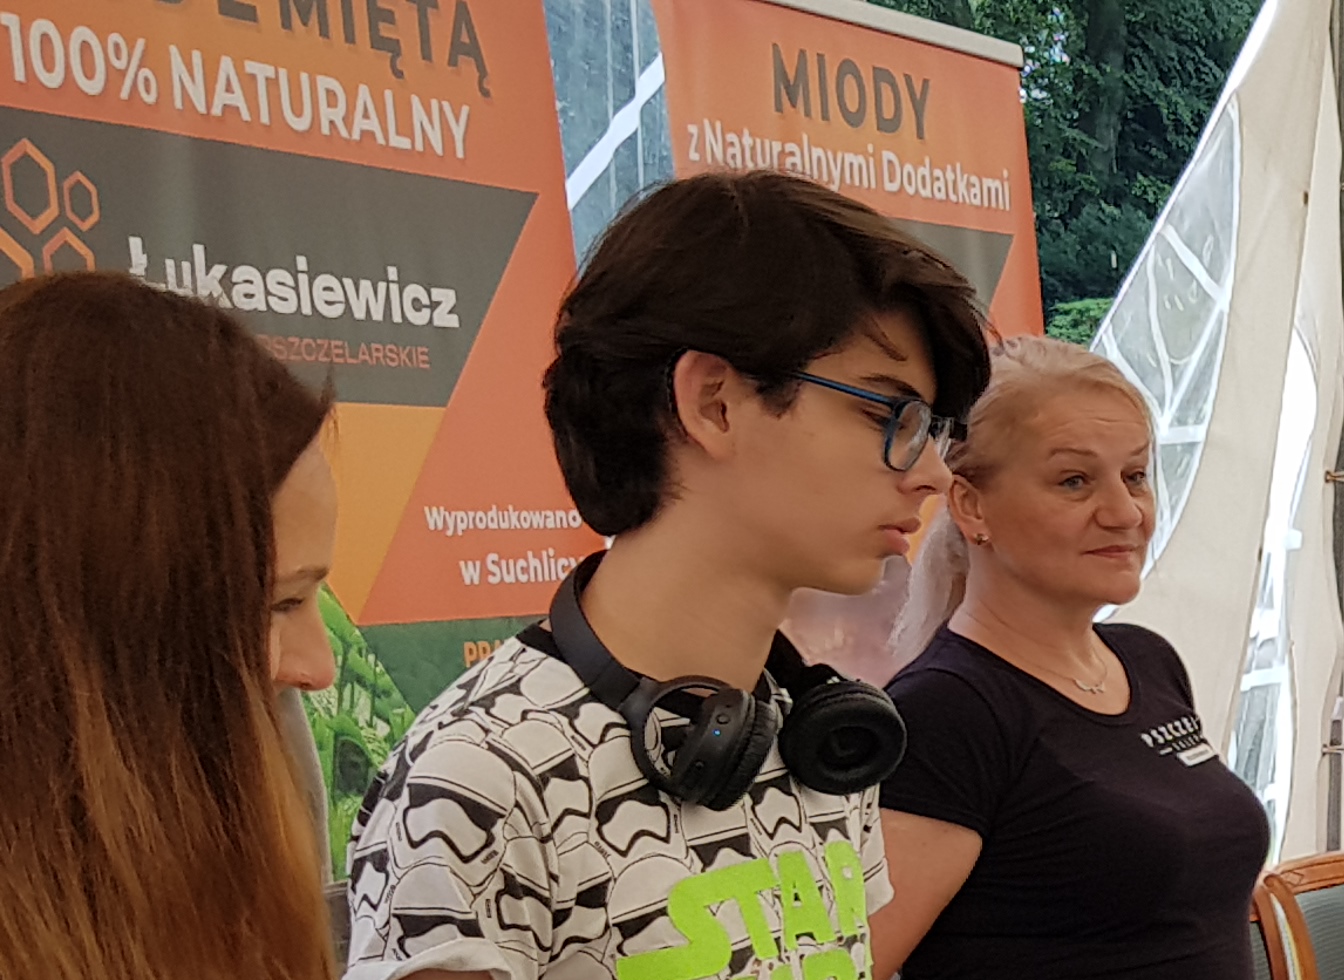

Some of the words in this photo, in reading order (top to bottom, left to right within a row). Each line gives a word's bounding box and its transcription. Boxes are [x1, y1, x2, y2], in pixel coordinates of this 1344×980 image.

[0, 12, 158, 105] 100%
[169, 44, 471, 159] NATURALNY
[771, 42, 931, 140] MIODY
[687, 123, 700, 161] z
[703, 118, 876, 193] Naturalnymi
[881, 150, 1011, 211] Dodatkami
[128, 235, 460, 328] Łukasiewicz
[424, 504, 583, 537] Wyprodukowano
[459, 560, 481, 586] w
